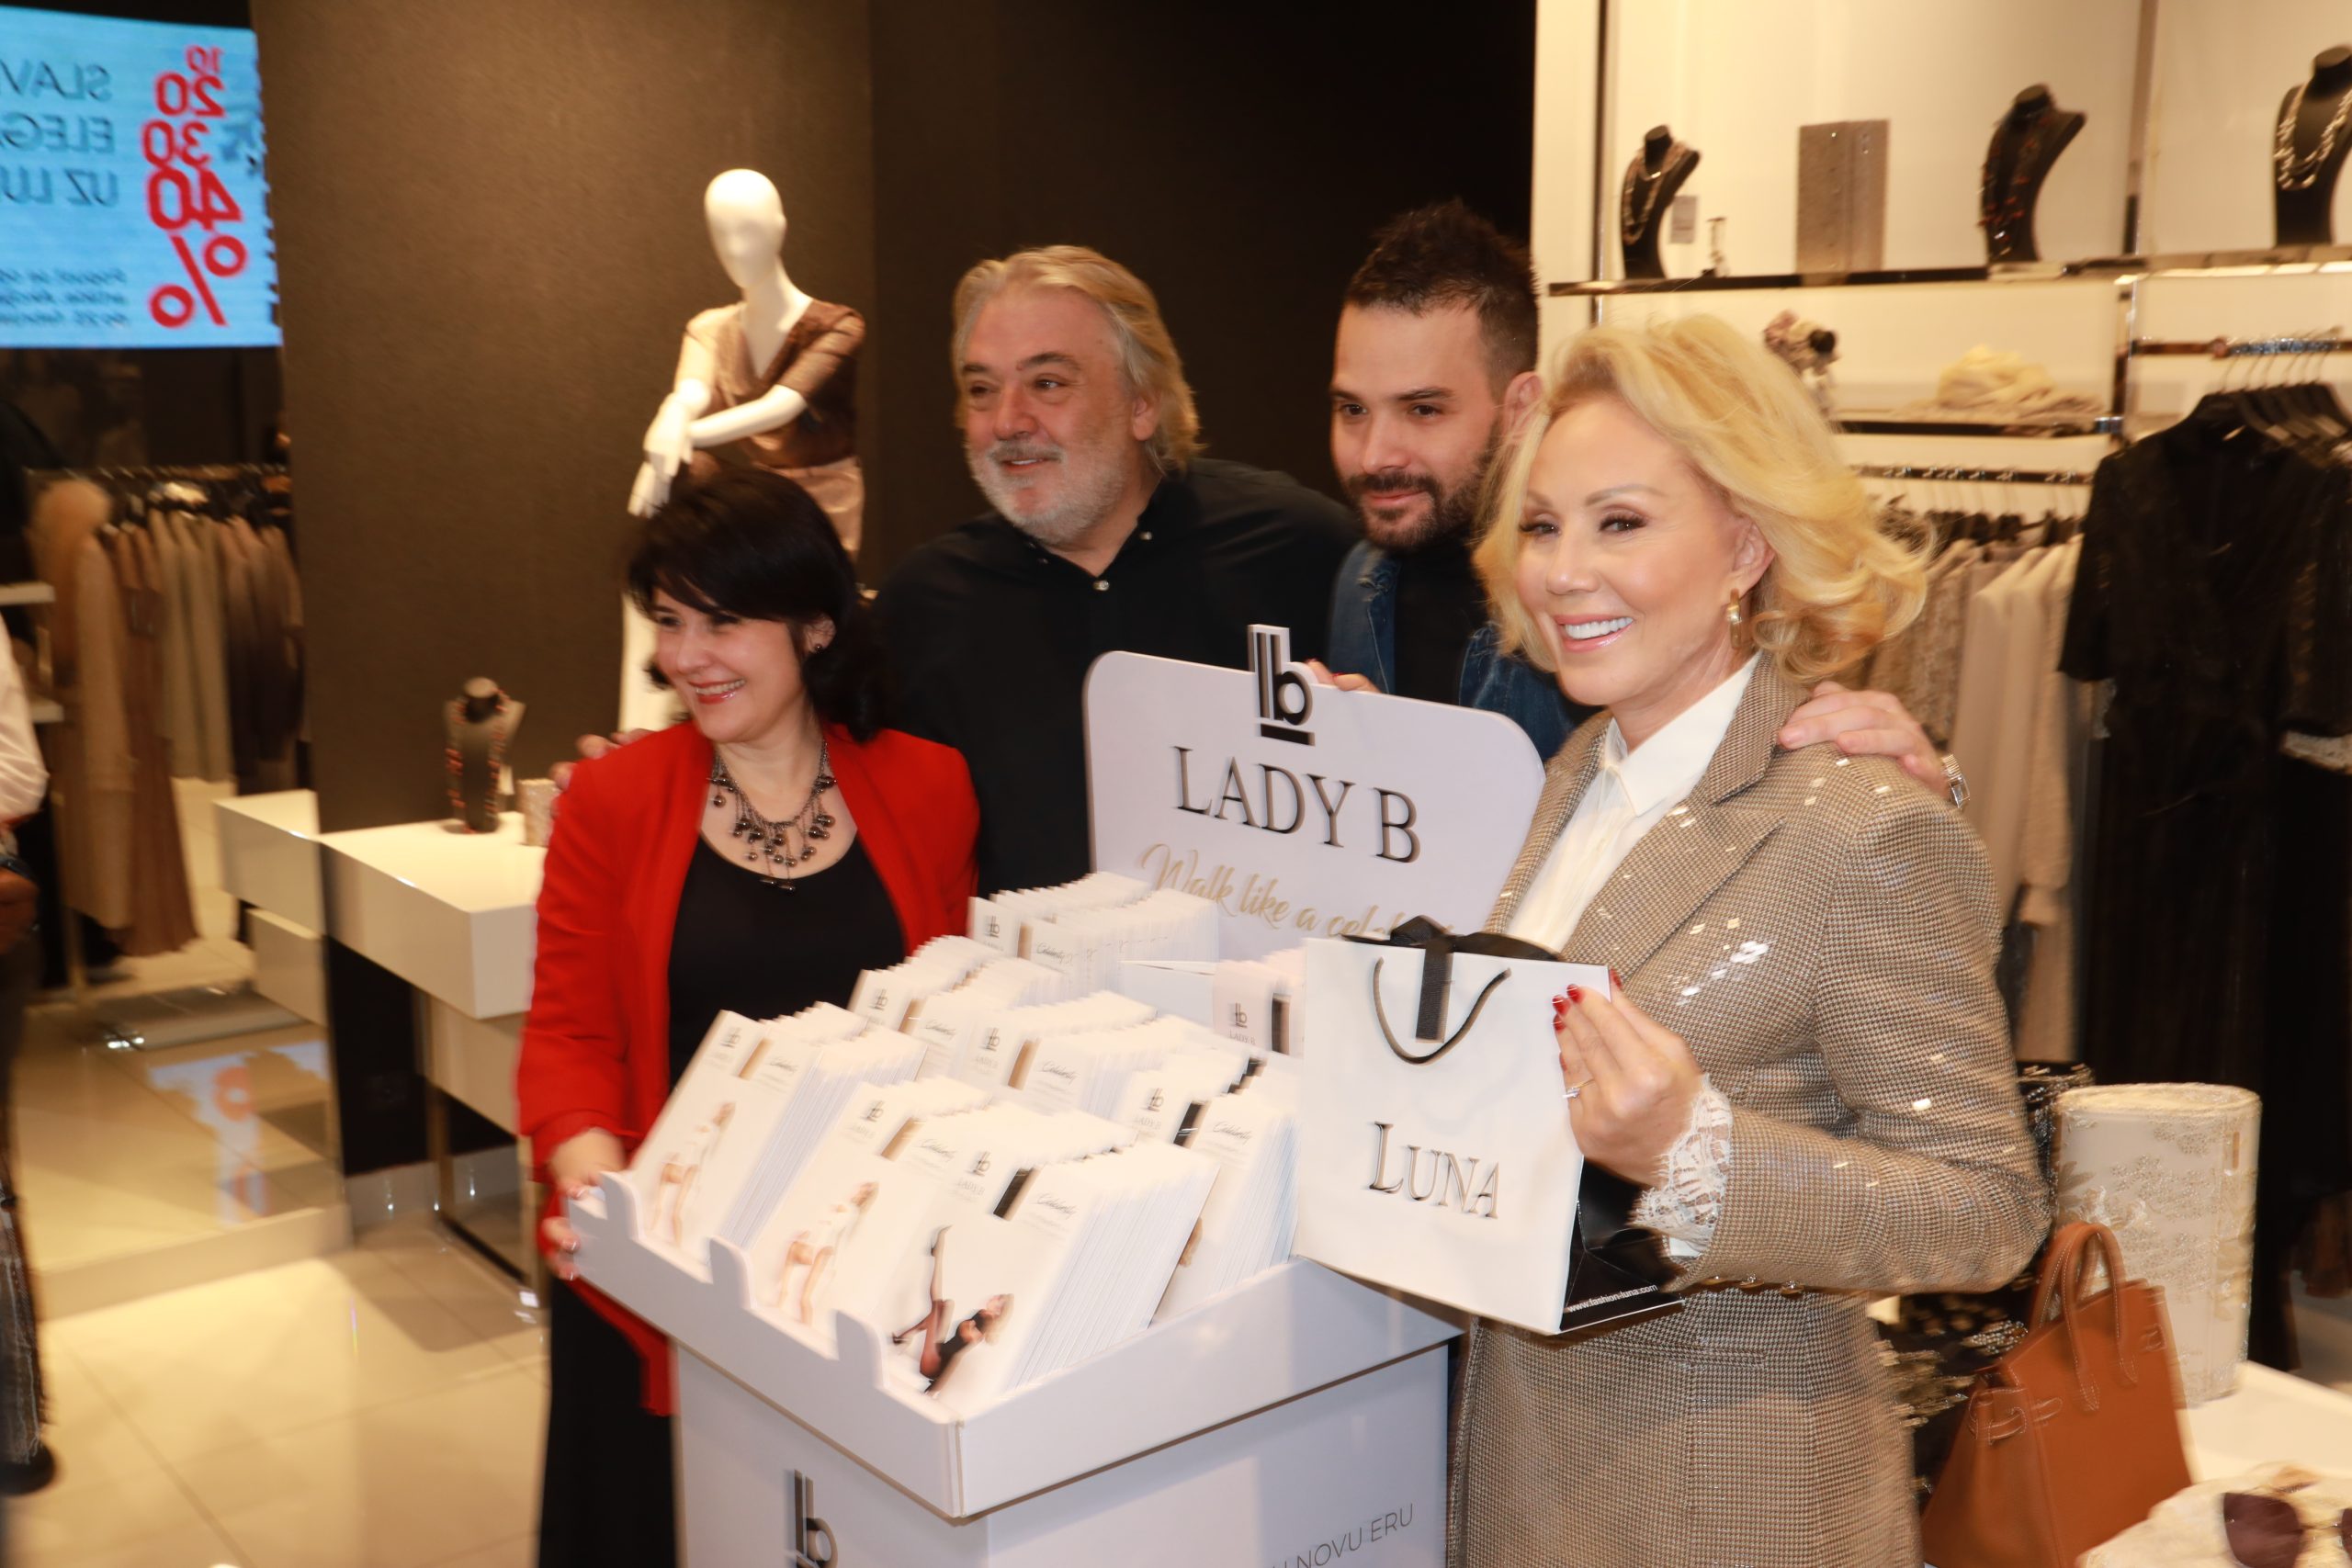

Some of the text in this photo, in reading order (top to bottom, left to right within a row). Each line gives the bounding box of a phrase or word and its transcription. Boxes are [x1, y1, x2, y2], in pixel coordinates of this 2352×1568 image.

[1172, 745, 1421, 863] LADY B
[1140, 842, 1237, 917] Walk
[1238, 872, 1292, 930] like
[1296, 907, 1317, 931] a
[1368, 1121, 1499, 1220] LUNA
[1567, 1284, 1658, 1313] www.fashion-luna.com
[1296, 1503, 1414, 1568] NOVU ERU
